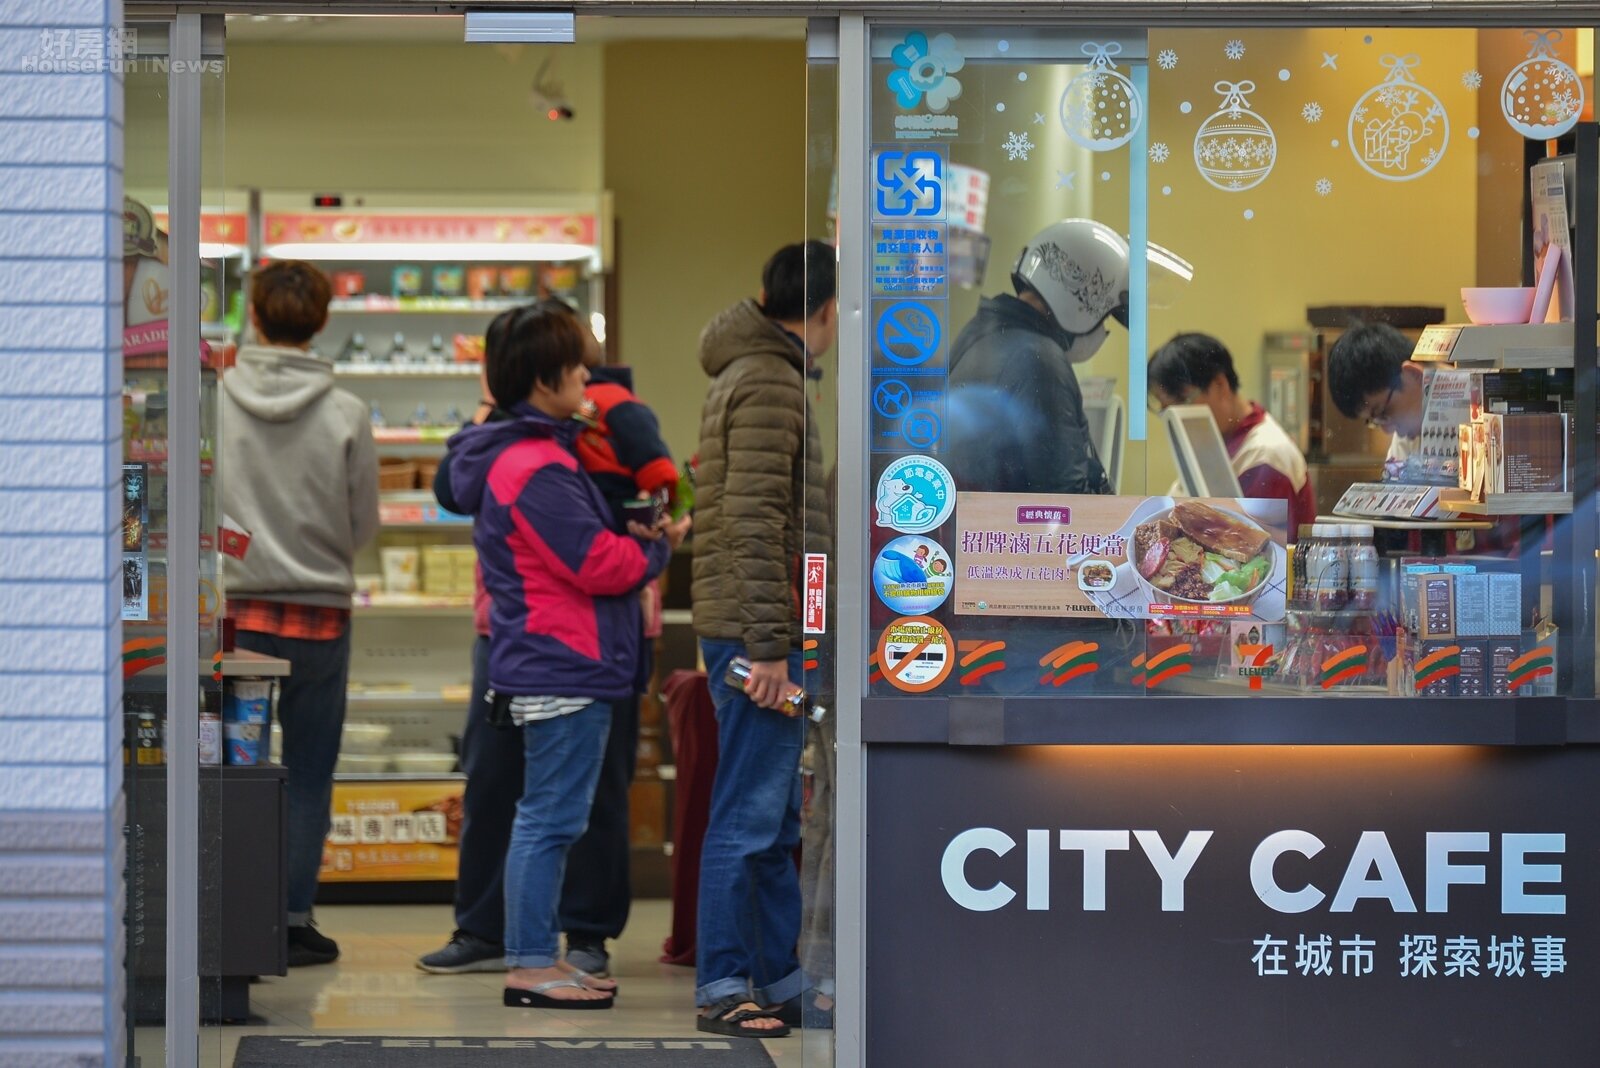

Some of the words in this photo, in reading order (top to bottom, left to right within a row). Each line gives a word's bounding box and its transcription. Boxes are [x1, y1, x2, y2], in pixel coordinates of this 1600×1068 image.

[961, 531, 1124, 557] 招牌滷五花便當
[940, 827, 1214, 912] CITY
[1249, 829, 1567, 915] CAFE
[1251, 933, 1377, 977] 在城市
[1399, 934, 1568, 979] 探索城事
